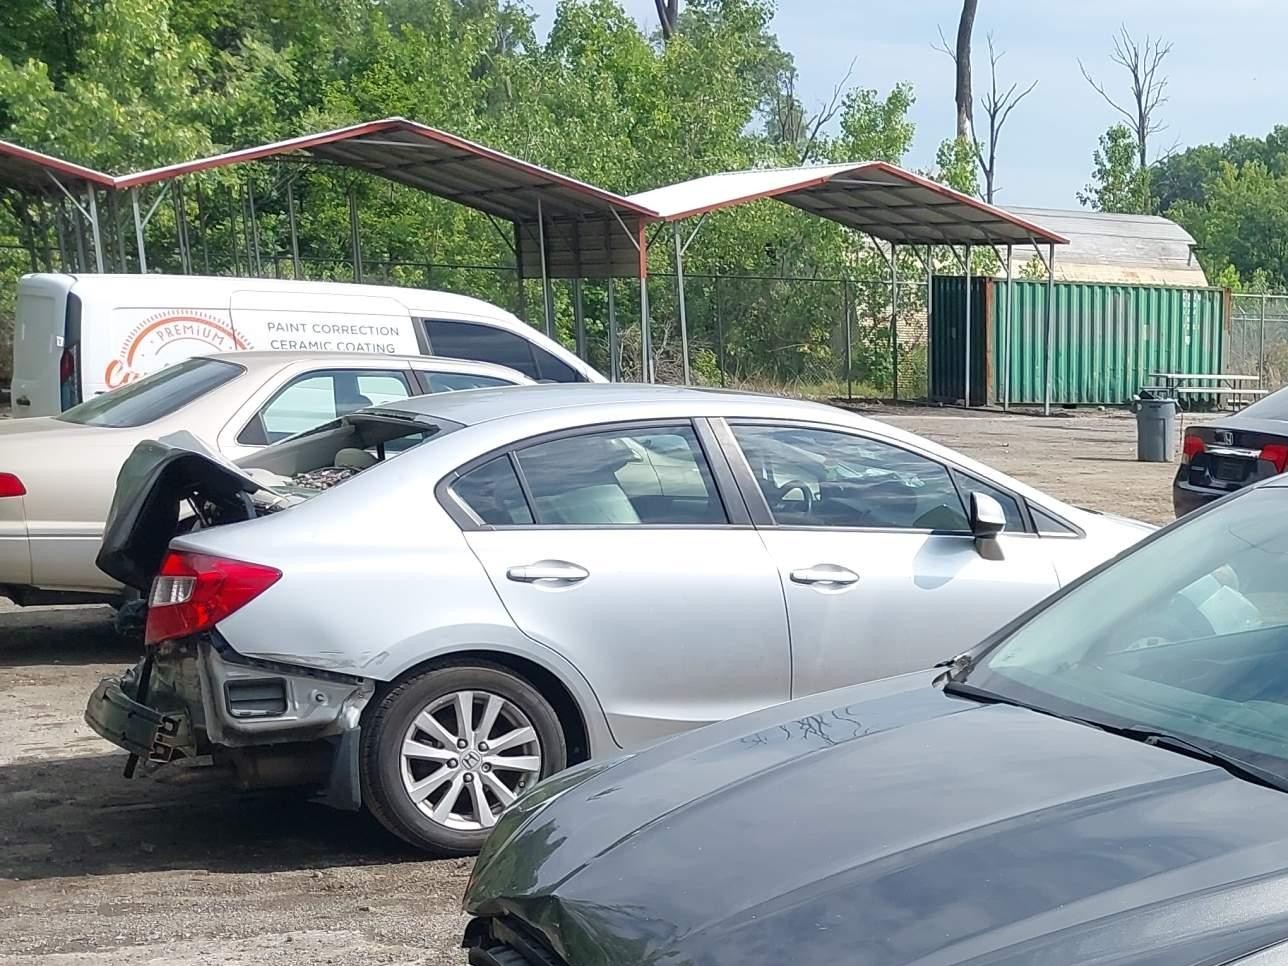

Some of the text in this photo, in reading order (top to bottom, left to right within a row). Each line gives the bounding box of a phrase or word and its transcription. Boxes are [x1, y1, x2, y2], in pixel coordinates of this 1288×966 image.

[267, 321, 400, 336] PAINT CORRECTION
[270, 339, 396, 354] CERAMIC COATING
